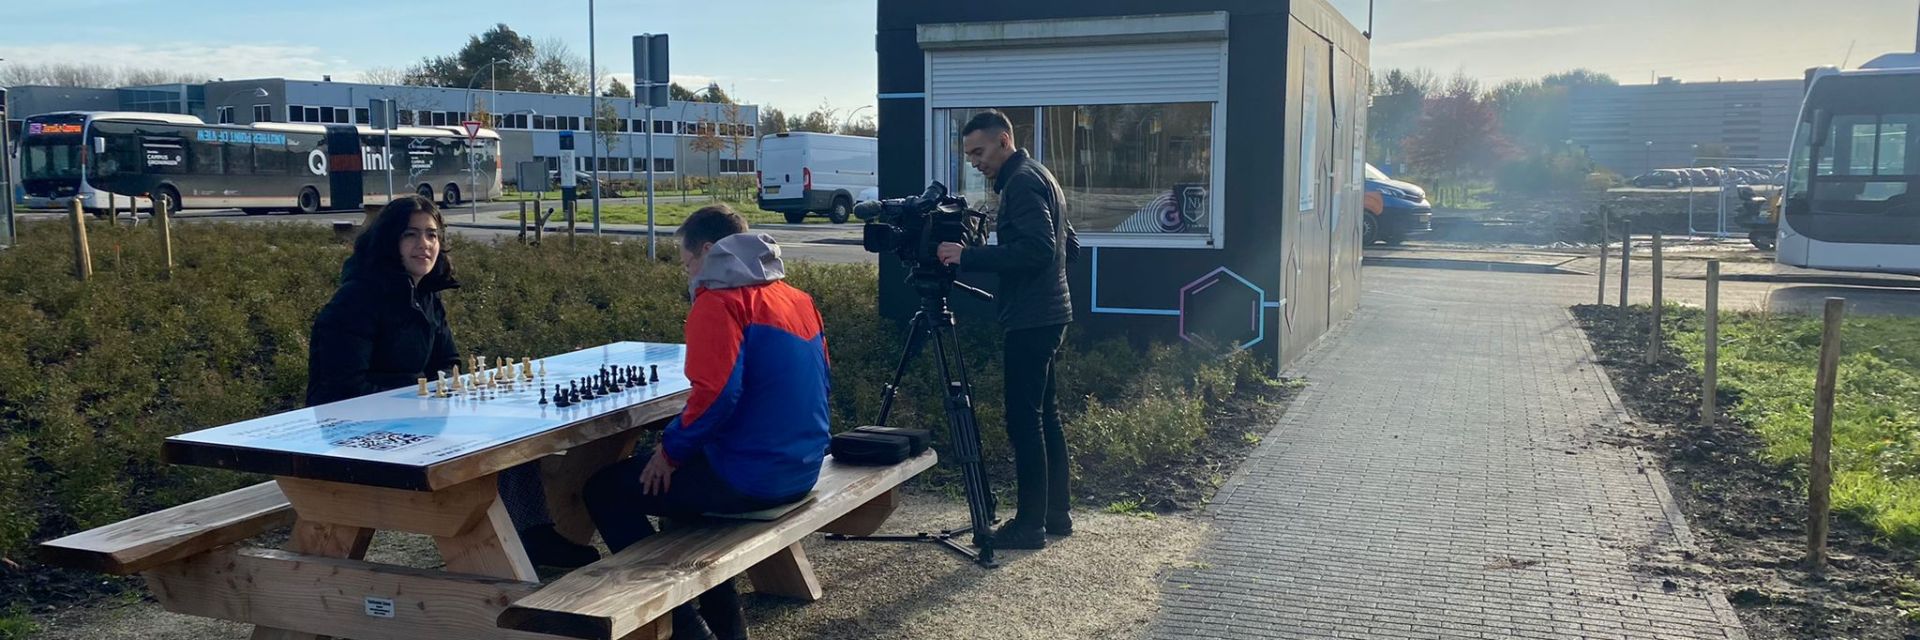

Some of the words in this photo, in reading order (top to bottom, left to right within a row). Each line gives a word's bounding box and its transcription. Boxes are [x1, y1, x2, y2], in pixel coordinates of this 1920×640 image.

[218, 131, 228, 142] OF
[308, 149, 328, 176] Q
[361, 145, 395, 170] link
